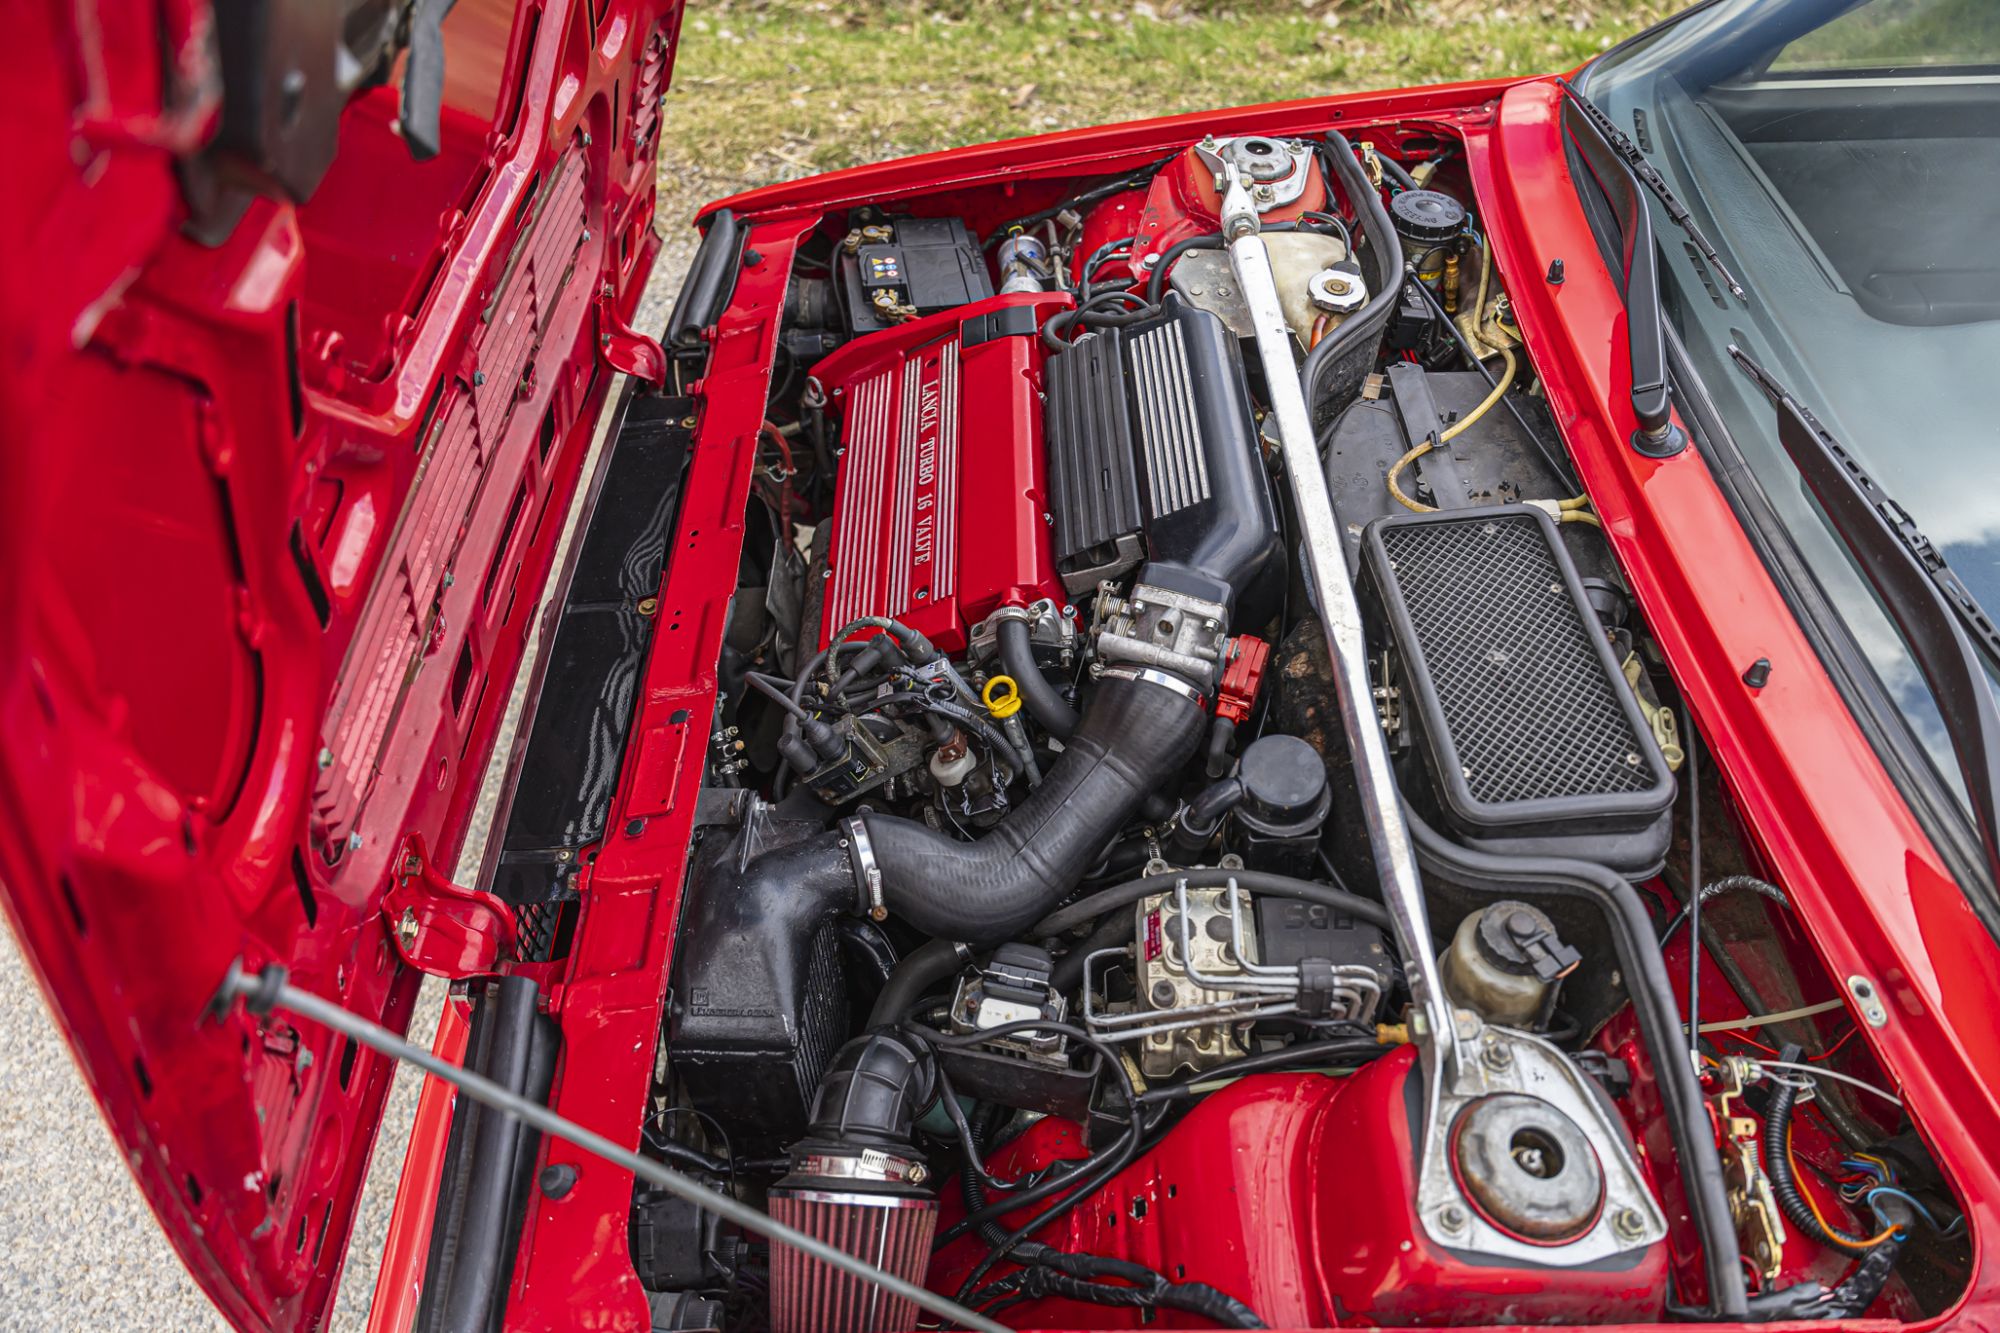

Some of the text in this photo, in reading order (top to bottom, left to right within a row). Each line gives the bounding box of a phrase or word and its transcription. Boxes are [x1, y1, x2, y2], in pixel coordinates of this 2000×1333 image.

[914, 379, 939, 566] LANCIA TURBO 16 VALVE
[1284, 904, 1354, 931] ABS
